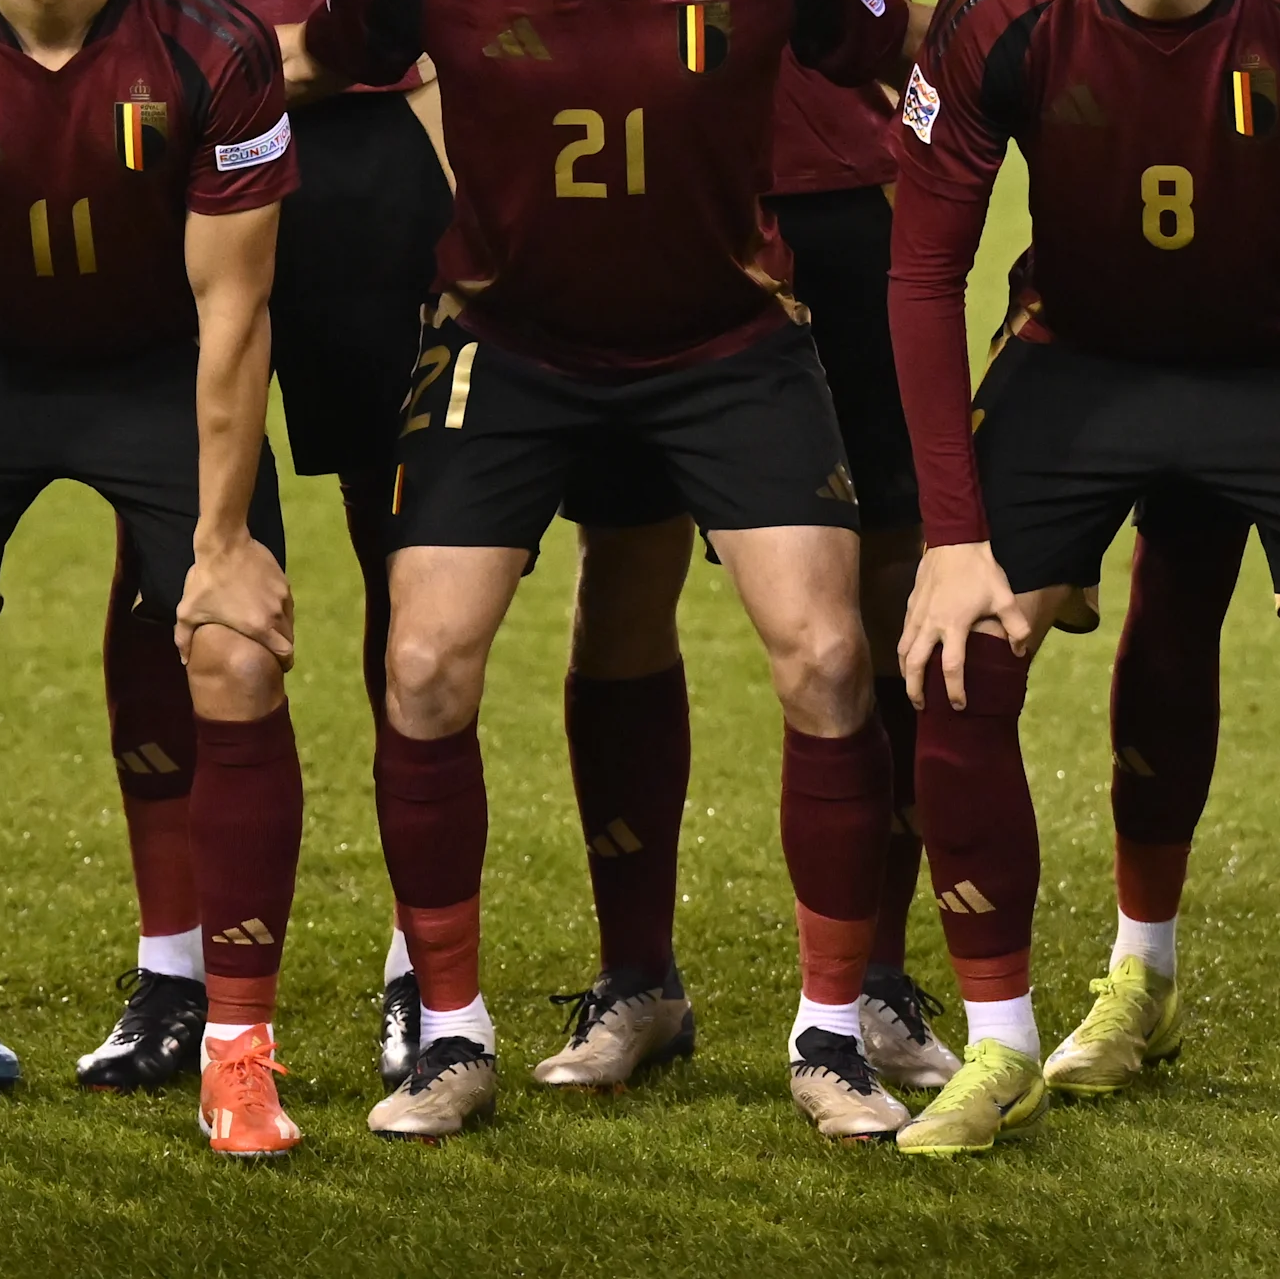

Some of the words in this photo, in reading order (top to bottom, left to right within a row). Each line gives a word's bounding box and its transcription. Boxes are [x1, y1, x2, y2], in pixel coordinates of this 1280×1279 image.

[219, 146, 240, 154] UEFA
[554, 108, 645, 199] 21
[29, 198, 98, 277] 11
[1141, 165, 1195, 250] 8
[400, 341, 480, 437] 21
